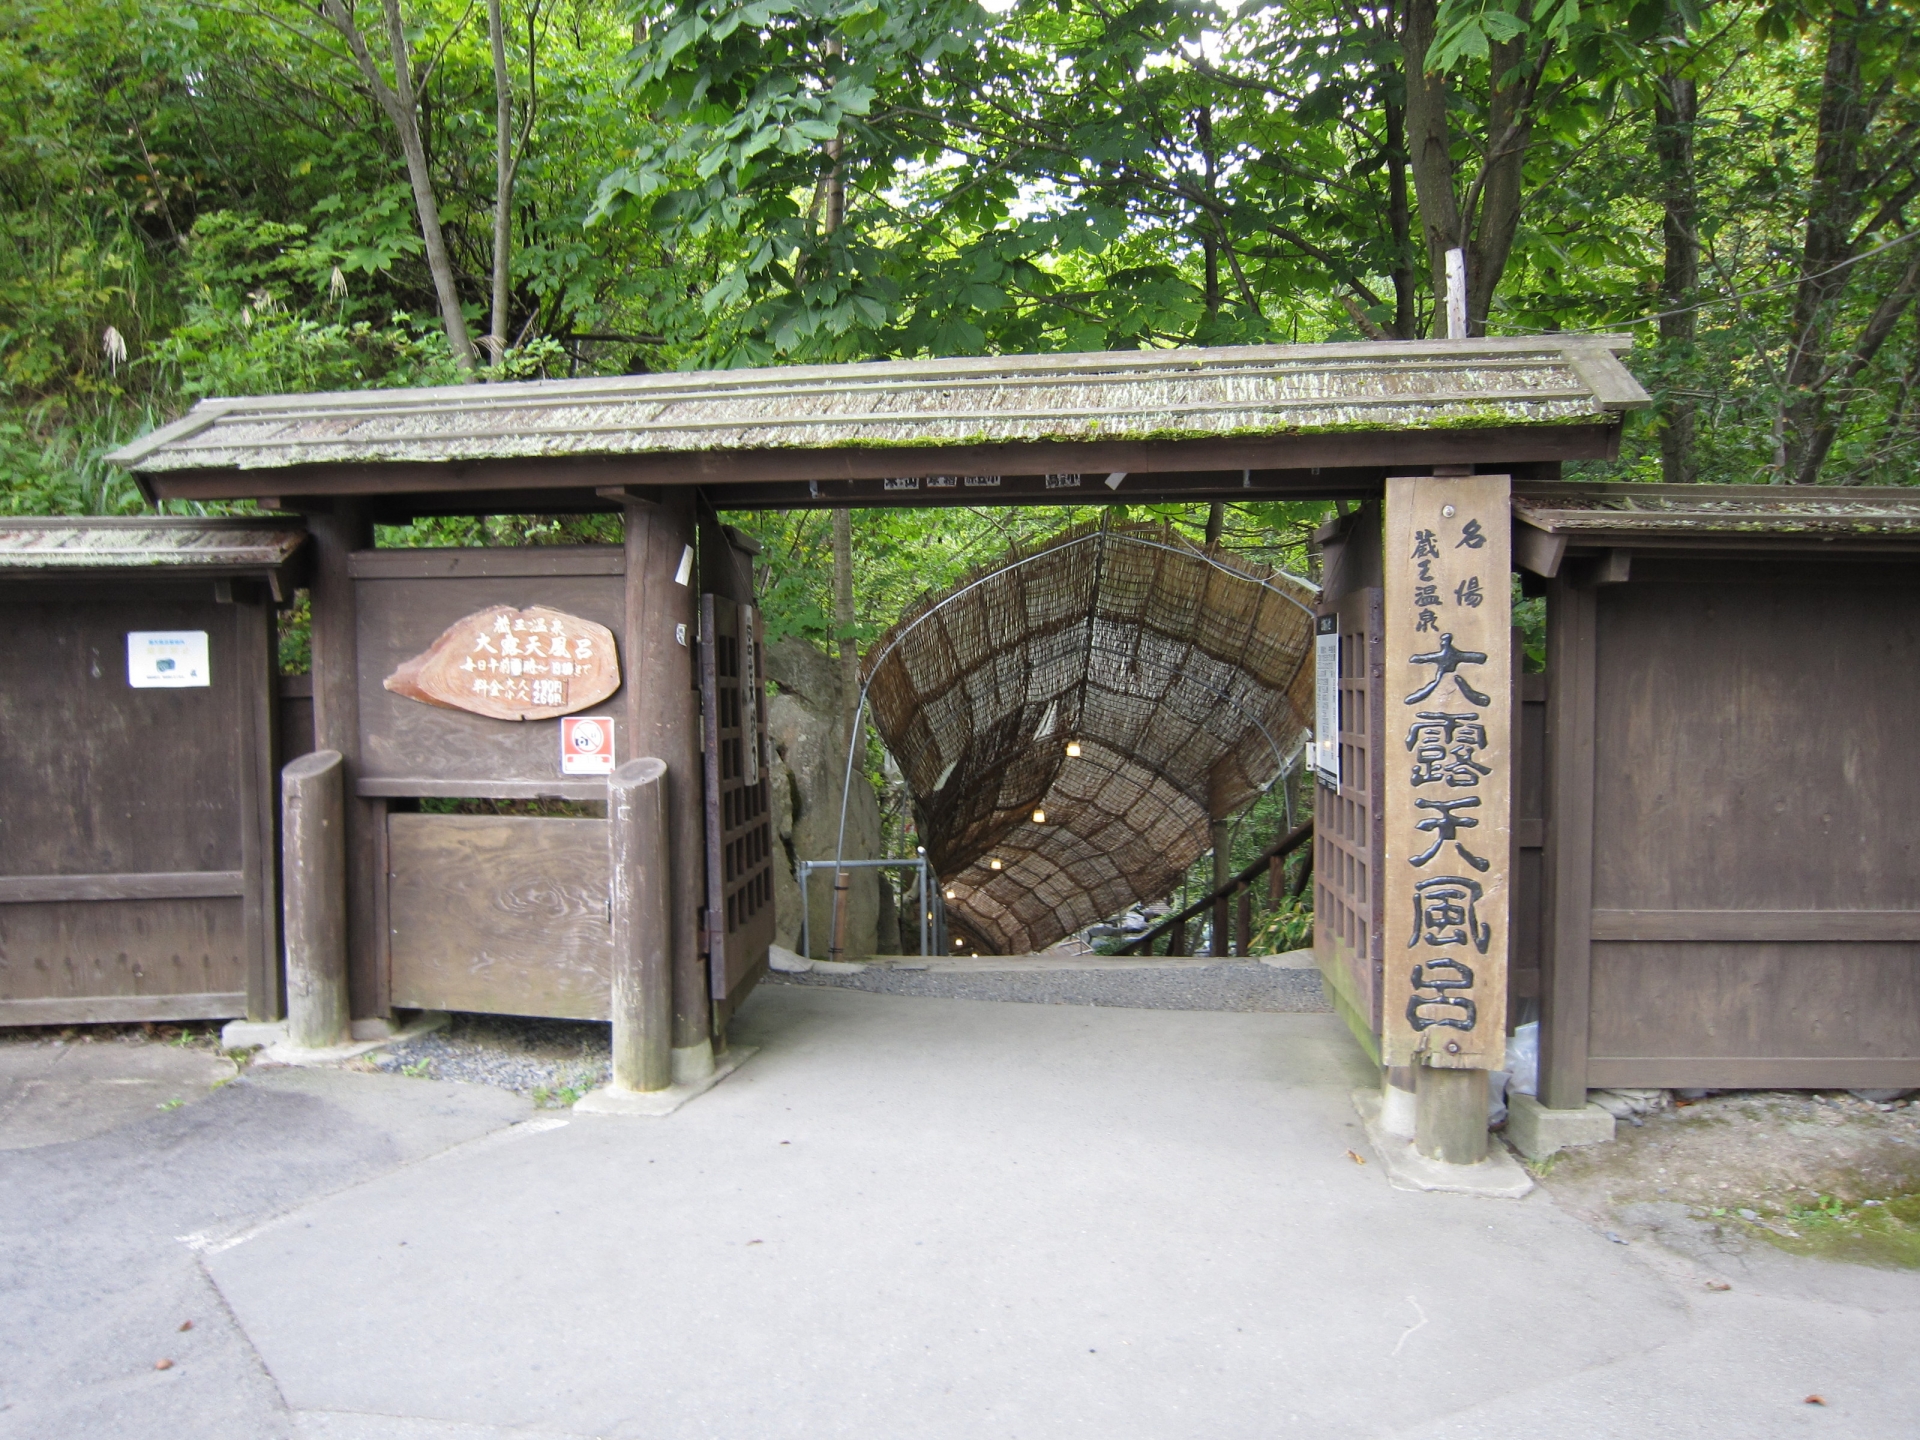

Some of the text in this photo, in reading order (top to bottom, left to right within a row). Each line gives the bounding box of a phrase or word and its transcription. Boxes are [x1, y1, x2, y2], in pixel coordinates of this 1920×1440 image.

[1410, 529, 1443, 633] 蔵王温泉
[473, 632, 593, 660] 大露天風呂
[493, 613, 566, 637] 蔵王温泉
[1404, 632, 1492, 1032] 大露天風呂
